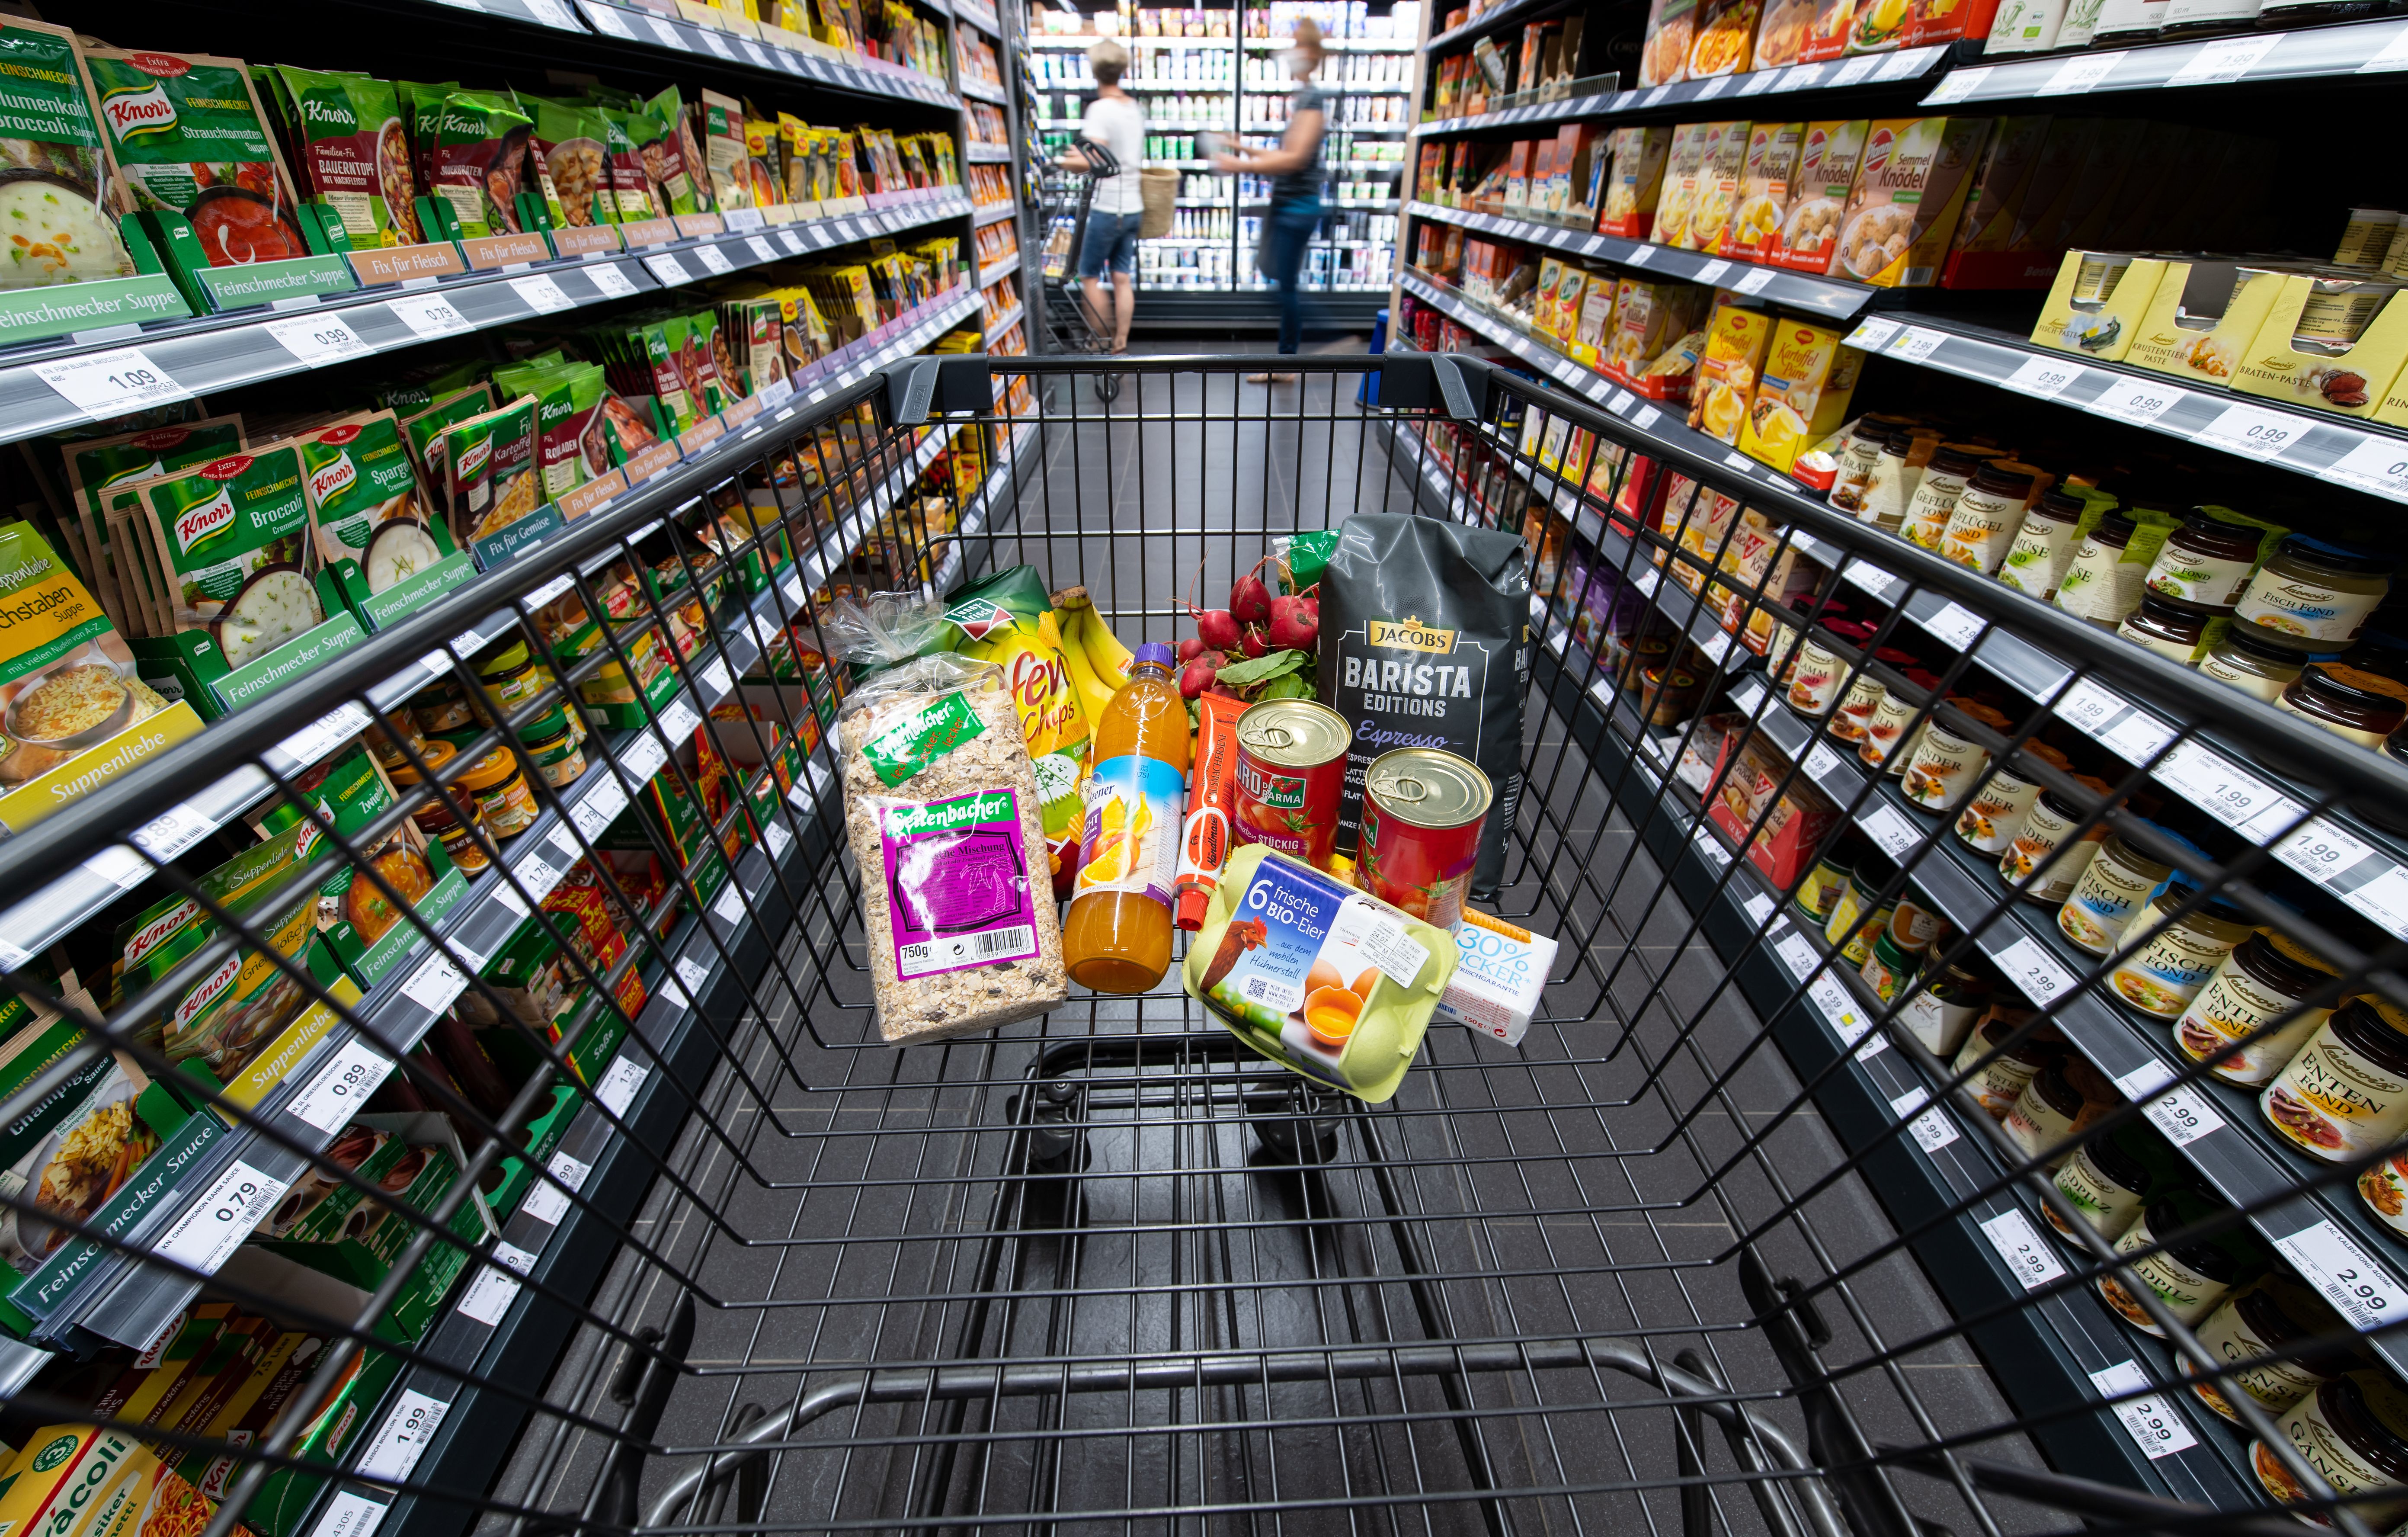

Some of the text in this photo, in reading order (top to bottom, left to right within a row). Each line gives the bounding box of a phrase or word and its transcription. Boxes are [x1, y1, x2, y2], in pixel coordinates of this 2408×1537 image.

[0, 90, 89, 118] lumenkohl
[108, 99, 171, 128] Knorr
[186, 97, 251, 111] FEINSCHMECKER
[304, 100, 356, 124] Knorr
[181, 125, 263, 141] Strauchtomaten
[443, 115, 487, 135] Knorr
[247, 142, 269, 153] Suppe
[315, 146, 355, 159] Familien-Fix
[319, 160, 375, 176] BAUERNTOPF
[323, 176, 368, 186] MIT HACKFLEISCH
[441, 165, 483, 177] SAUERBRATEN
[1879, 168, 1924, 190] Knödel
[373, 259, 391, 275] Fix
[393, 259, 409, 276] für
[412, 254, 448, 269] Fleisch
[215, 266, 346, 297] Feinschmecker Suppe
[0, 292, 177, 327] einschmecker Suppe
[314, 330, 347, 345] 0.99
[2038, 325, 2078, 339] FISCH-PASTE
[93, 356, 122, 368] BROCCOLI
[2133, 343, 2188, 361] KRUSTENTIER-
[2143, 354, 2167, 364] PASTE
[2259, 356, 2297, 370] Lacroix
[51, 375, 66, 383] 48G
[109, 369, 157, 389] 1.09
[2239, 366, 2311, 389] BRATEN-PASTE
[539, 401, 573, 420] Knorr
[2129, 395, 2162, 410] 0.99
[2247, 425, 2288, 443] 0.99
[459, 443, 491, 471] Knorr
[494, 433, 532, 463] Kartoffel
[545, 440, 577, 459] ROULADEN
[246, 474, 300, 501] FEINSCHMECKER
[250, 493, 302, 528] Broccoli
[1961, 491, 2006, 513] Lacroix
[178, 503, 232, 542] Knorr
[490, 517, 550, 556] Fix für Gemüse
[2166, 549, 2204, 565] Lacroix
[2181, 568, 2211, 581] FOND
[2263, 591, 2335, 616] FISCH FOND
[2277, 584, 2334, 603] Lacroix
[52, 602, 85, 624] Suppe
[7, 624, 101, 674] mit vielen Nudeln von A-Z
[1375, 627, 1447, 648] JACOBS
[228, 624, 357, 702] Feinschmecker Suppe
[1345, 656, 1471, 698] BARISTA
[1364, 693, 1446, 717] EDITIONS
[1025, 702, 1075, 742] Chips
[1356, 719, 1449, 749] Espresso
[51, 731, 166, 802] Suppenliebe
[1237, 759, 1262, 793] ORO
[1262, 789, 1301, 803] PARMA
[2214, 783, 2252, 808] 1.99
[958, 843, 1005, 857] Mischung
[1207, 814, 1217, 867] Händlmaier
[1258, 834, 1299, 849] STÜCKIG
[2297, 835, 2340, 863] 1.99
[1249, 879, 1319, 918] 6 frische
[2080, 886, 2115, 914] FOND
[2084, 870, 2133, 910] FISCH
[1268, 902, 1326, 940] BIO-Eier
[902, 947, 929, 959] 750g
[1269, 950, 1299, 966] mobilen
[1294, 945, 1311, 956] dem
[1457, 927, 1532, 972] 30%
[1250, 955, 1302, 979] Hühnerstall
[2027, 967, 2056, 992] 2.99
[2145, 958, 2197, 982] FOND
[179, 959, 240, 1021] Knorr
[251, 1007, 333, 1089] Suppenliebe
[84, 1057, 109, 1084] Sauce
[356, 1063, 380, 1087] 100G=2.47
[2317, 1040, 2404, 1093] Lacroix
[304, 1059, 343, 1102] GRIESSKLOESSCHEN-
[332, 1064, 366, 1096] 0.89
[2301, 1050, 2386, 1115] ENTEN
[2299, 1075, 2354, 1114] FOND
[2161, 1097, 2199, 1128] 2.99
[167, 1126, 212, 1173] Sauce
[172, 1168, 241, 1241] CHAMPIGNON RAHM SAUCE
[215, 1182, 259, 1222] 0.79
[245, 1180, 275, 1212] 100G=2.14
[2018, 1244, 2045, 1274] 2.99
[2325, 1224, 2393, 1289] LAC. KALBS-FOND 400ML
[2337, 1269, 2387, 1311] 2.99
[2356, 1300, 2383, 1326] 1L=7.48
[397, 1408, 426, 1444] 1.99
[2136, 1403, 2171, 1441] 2.99
[366, 1405, 406, 1466] FLEISCH BOUILLON 150G
[333, 1510, 354, 1537] 4305
